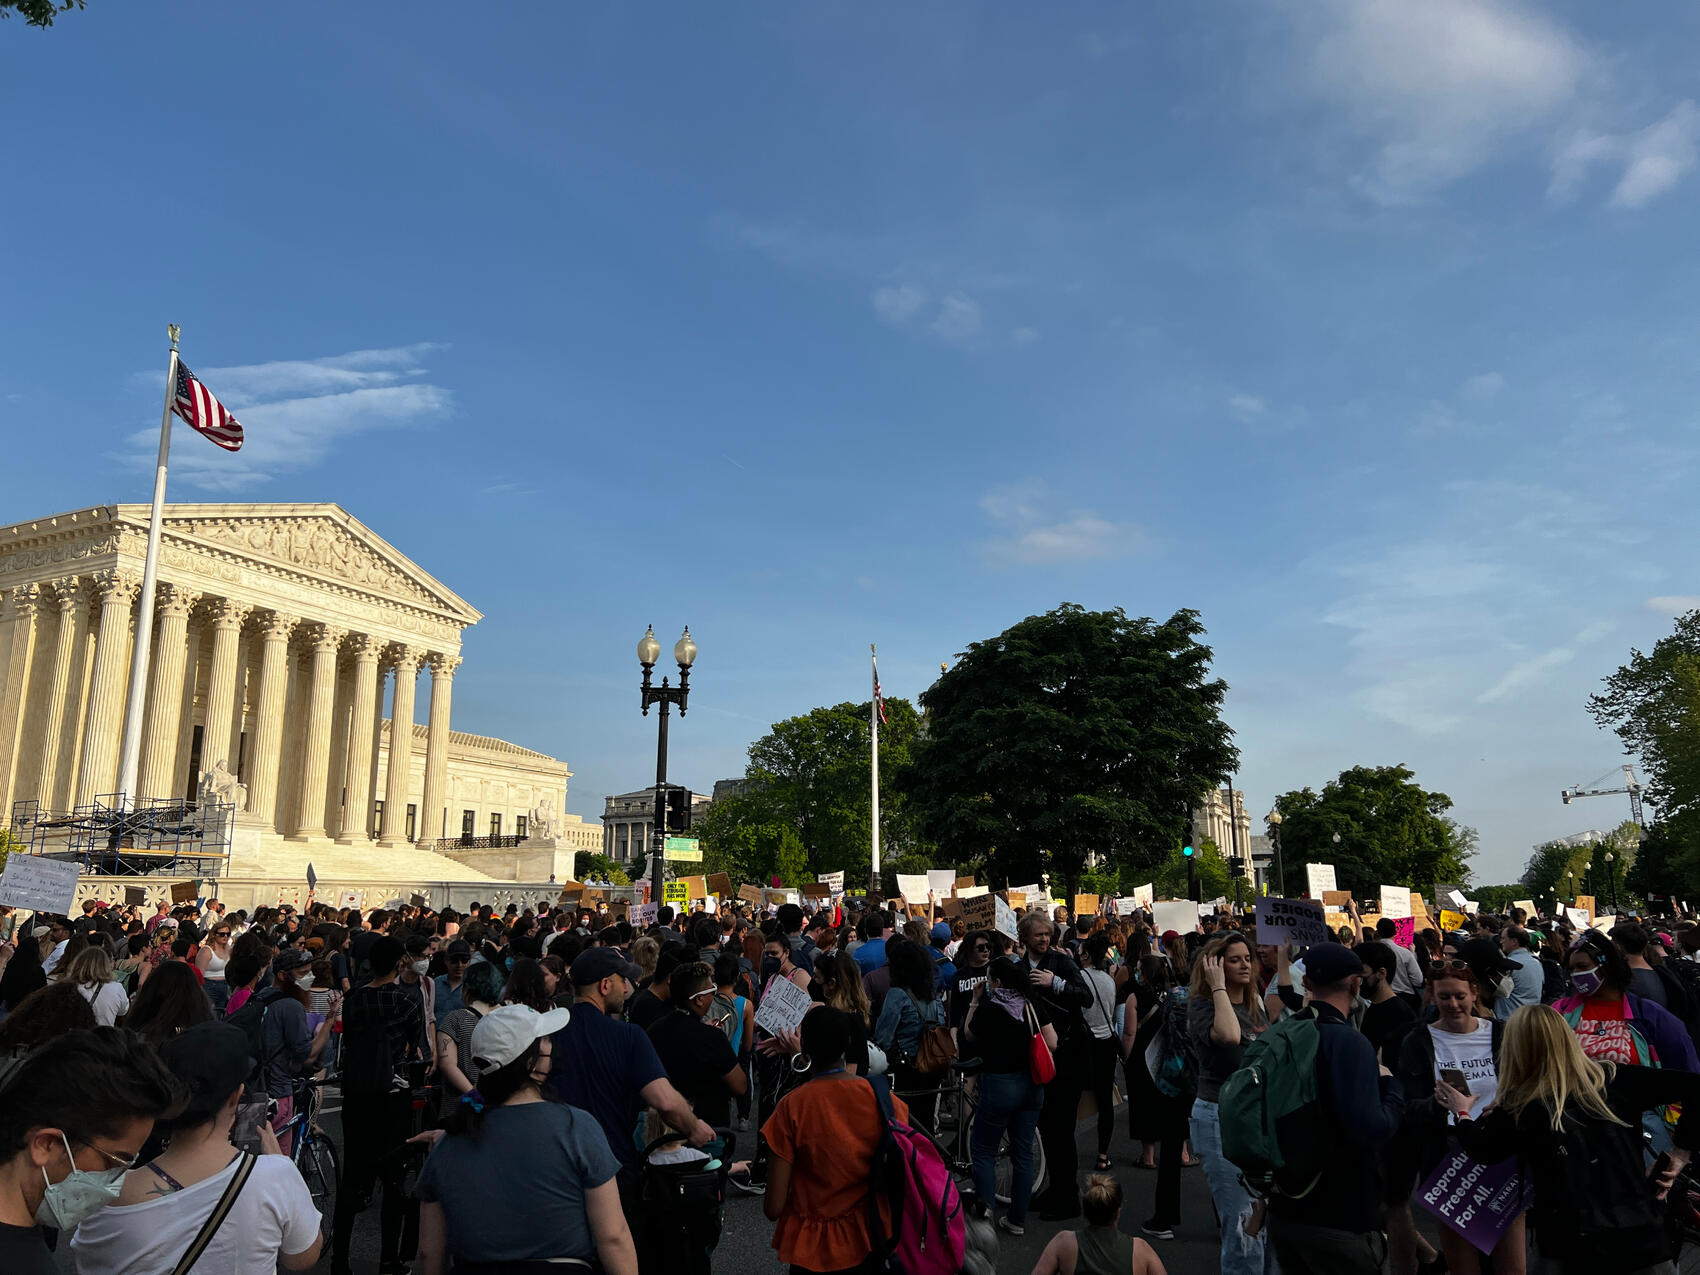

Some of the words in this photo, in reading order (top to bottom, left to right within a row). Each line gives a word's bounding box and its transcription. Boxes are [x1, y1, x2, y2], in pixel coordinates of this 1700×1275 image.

[1264, 915, 1297, 926] OUR
[1272, 902, 1322, 921] BODIES
[1455, 1204, 1476, 1228] For
[1472, 1185, 1494, 1206] All.
